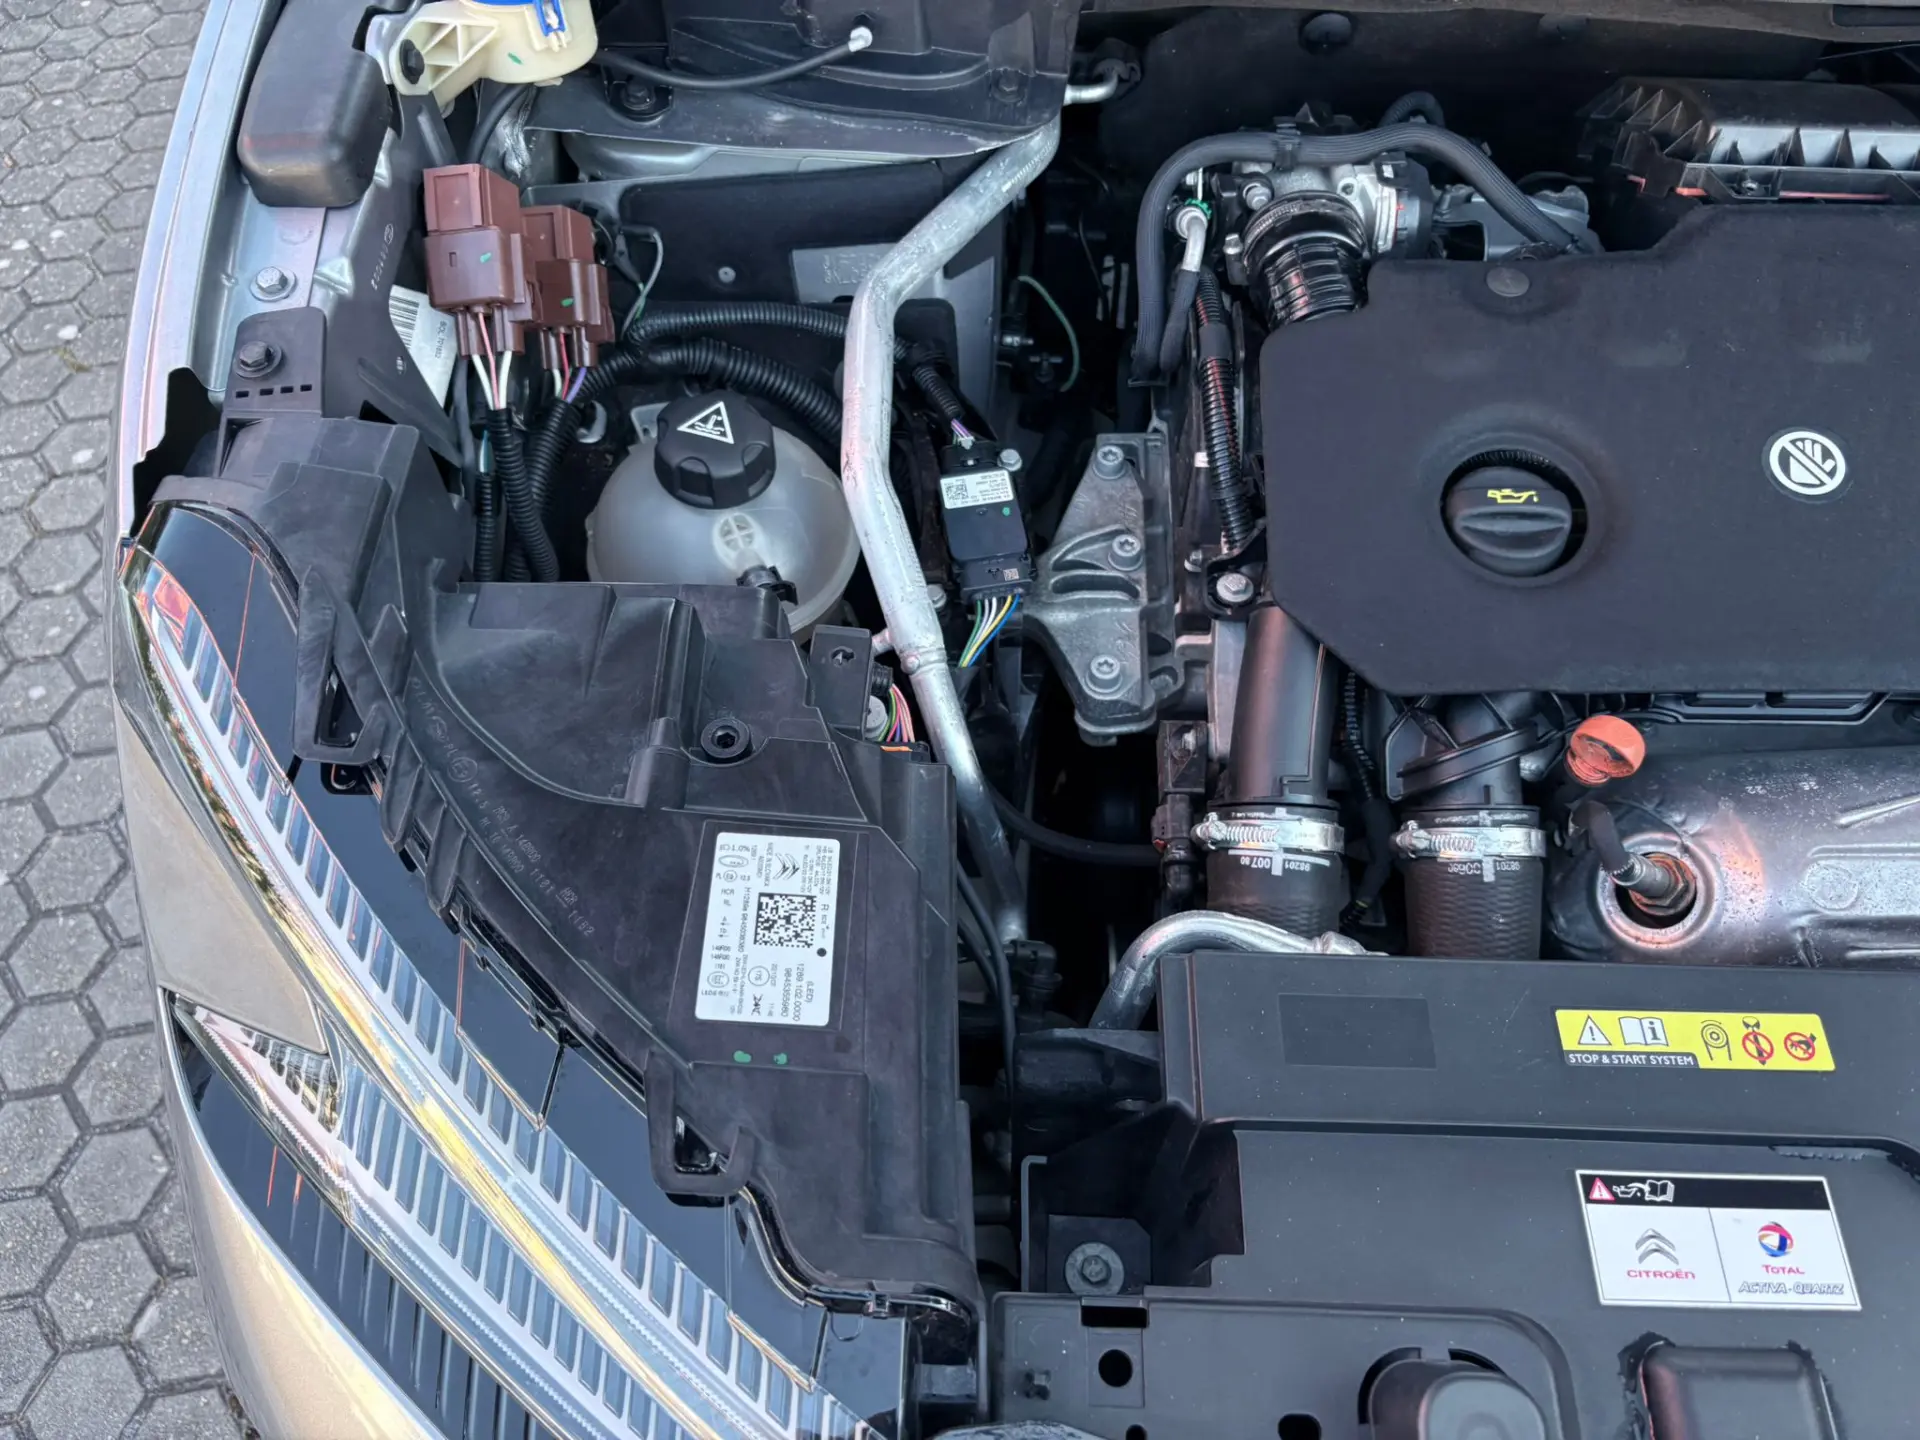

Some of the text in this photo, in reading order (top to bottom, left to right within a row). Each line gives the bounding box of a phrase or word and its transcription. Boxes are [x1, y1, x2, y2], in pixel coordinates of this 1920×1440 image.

[1285, 860, 1311, 872] 98201
[1569, 1053, 1694, 1066] STOP & START SYSTEM
[1761, 1263, 1806, 1276] TOTAL
